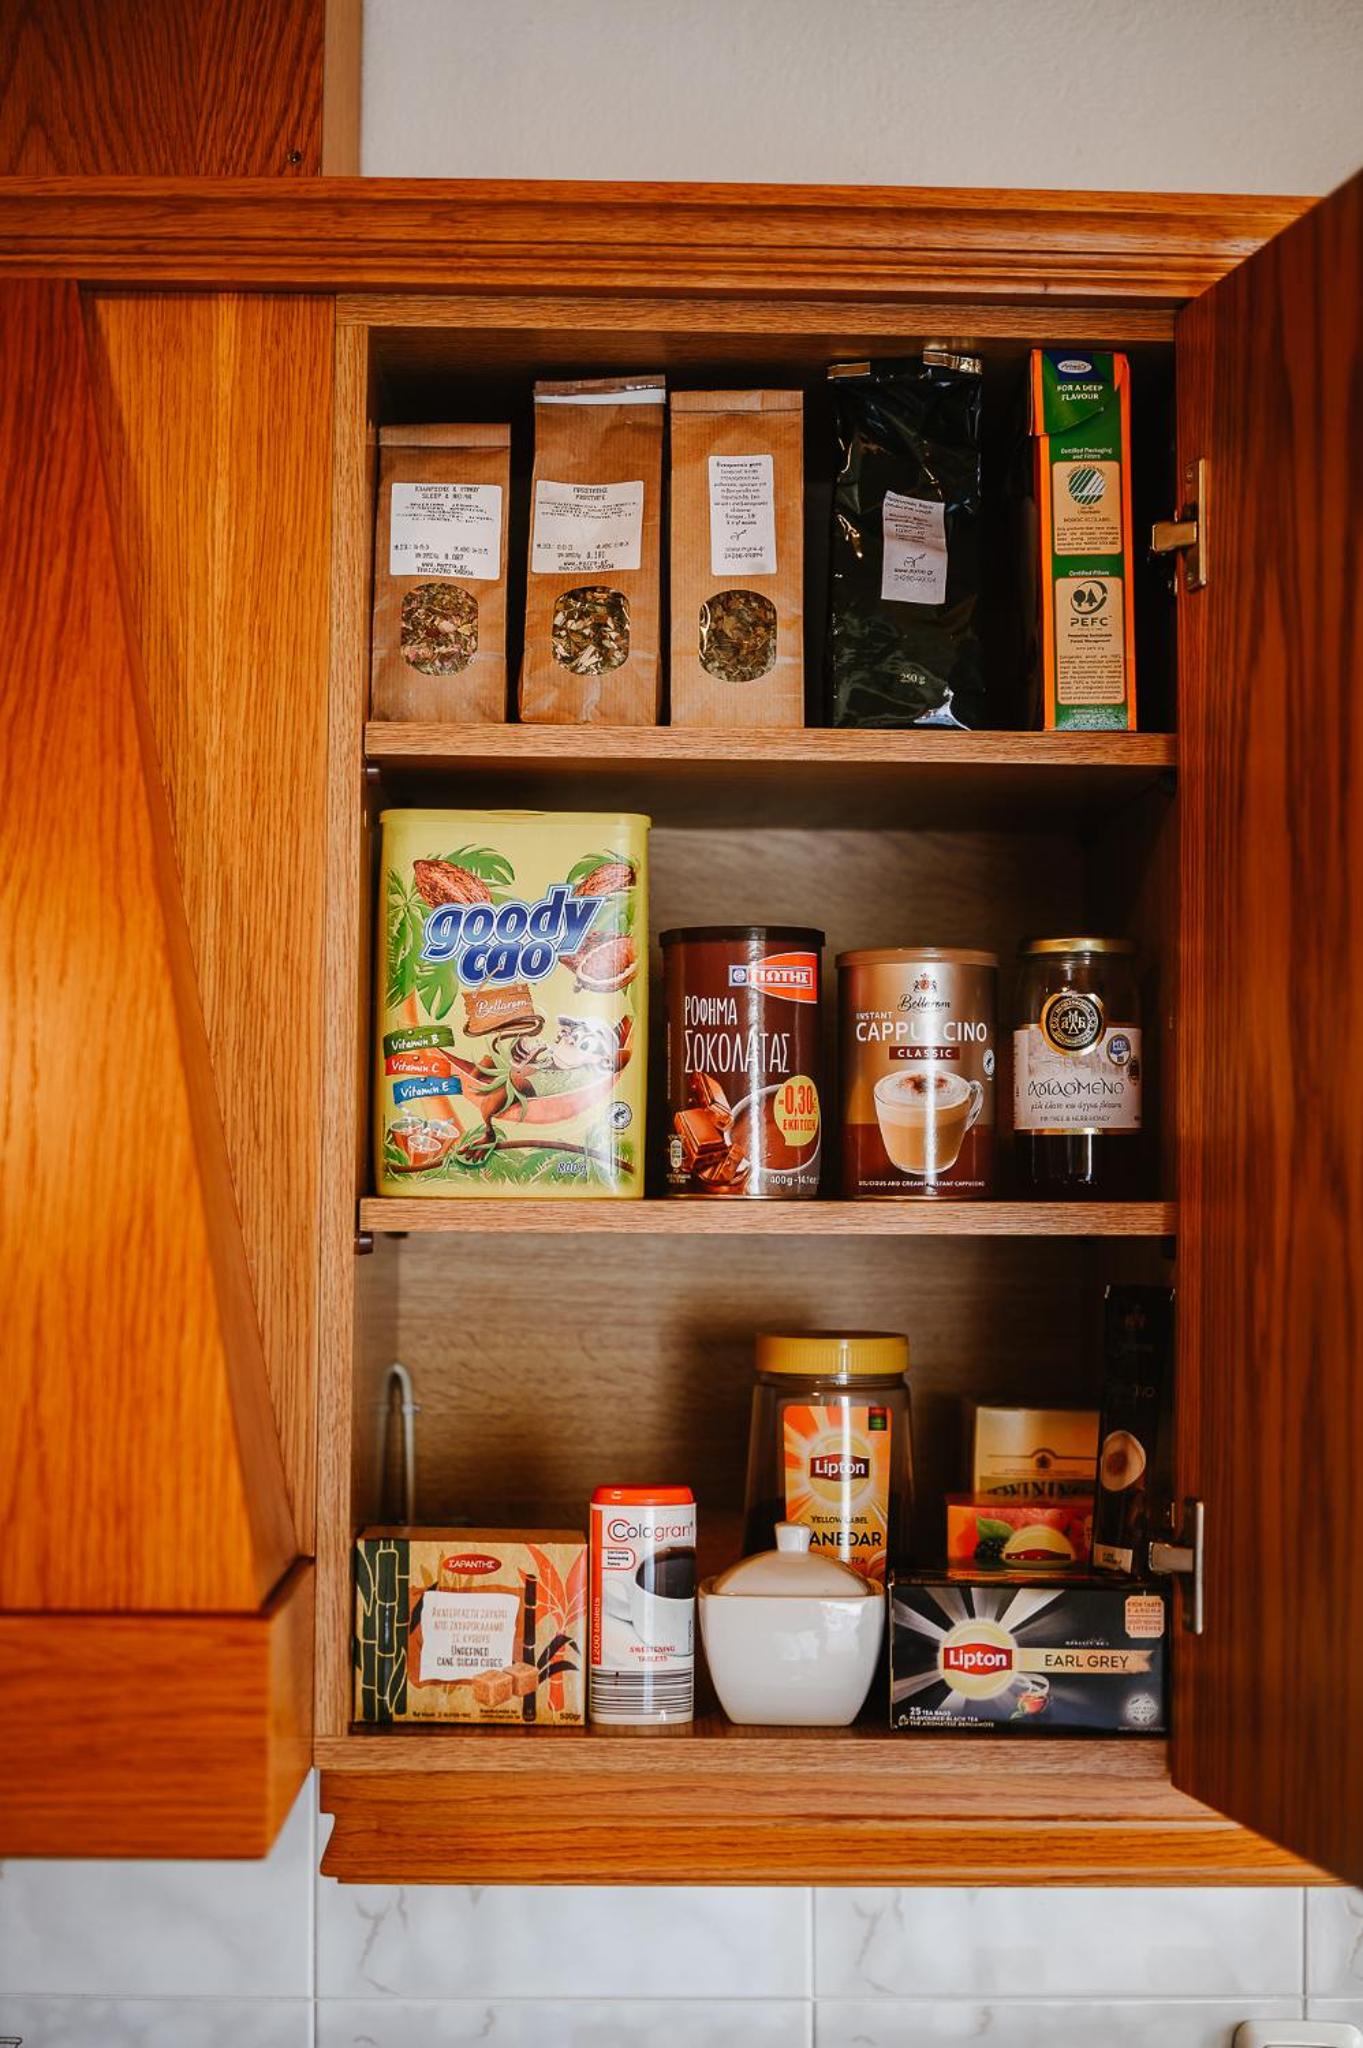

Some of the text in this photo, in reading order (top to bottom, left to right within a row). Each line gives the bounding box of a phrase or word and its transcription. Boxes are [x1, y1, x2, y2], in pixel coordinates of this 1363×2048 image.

[1070, 617, 1108, 627] PEFC
[424, 886, 602, 958] goody
[460, 940, 552, 984] cao
[684, 995, 738, 1026] ΡΟΦΗΜΑ
[856, 1011, 893, 1020] INSTANT
[856, 1021, 987, 1042] CAPPUCINO
[391, 1034, 439, 1050] Vitamin B
[684, 1028, 790, 1073] ΣΟΚΟΛΑΤΑΣ
[897, 1049, 953, 1058] CLASSIC
[391, 1059, 439, 1073] Vitamin C
[401, 1081, 449, 1097] Vitamin E
[815, 1459, 865, 1477] Lipton
[608, 1519, 691, 1542] Cologran
[809, 1532, 881, 1546] ANEDAR
[437, 1657, 504, 1668] CANE SUGAR CUBES
[949, 1650, 1007, 1669] Lipton
[1044, 1654, 1129, 1668] EARL GREY
[910, 1706, 921, 1715] 25
